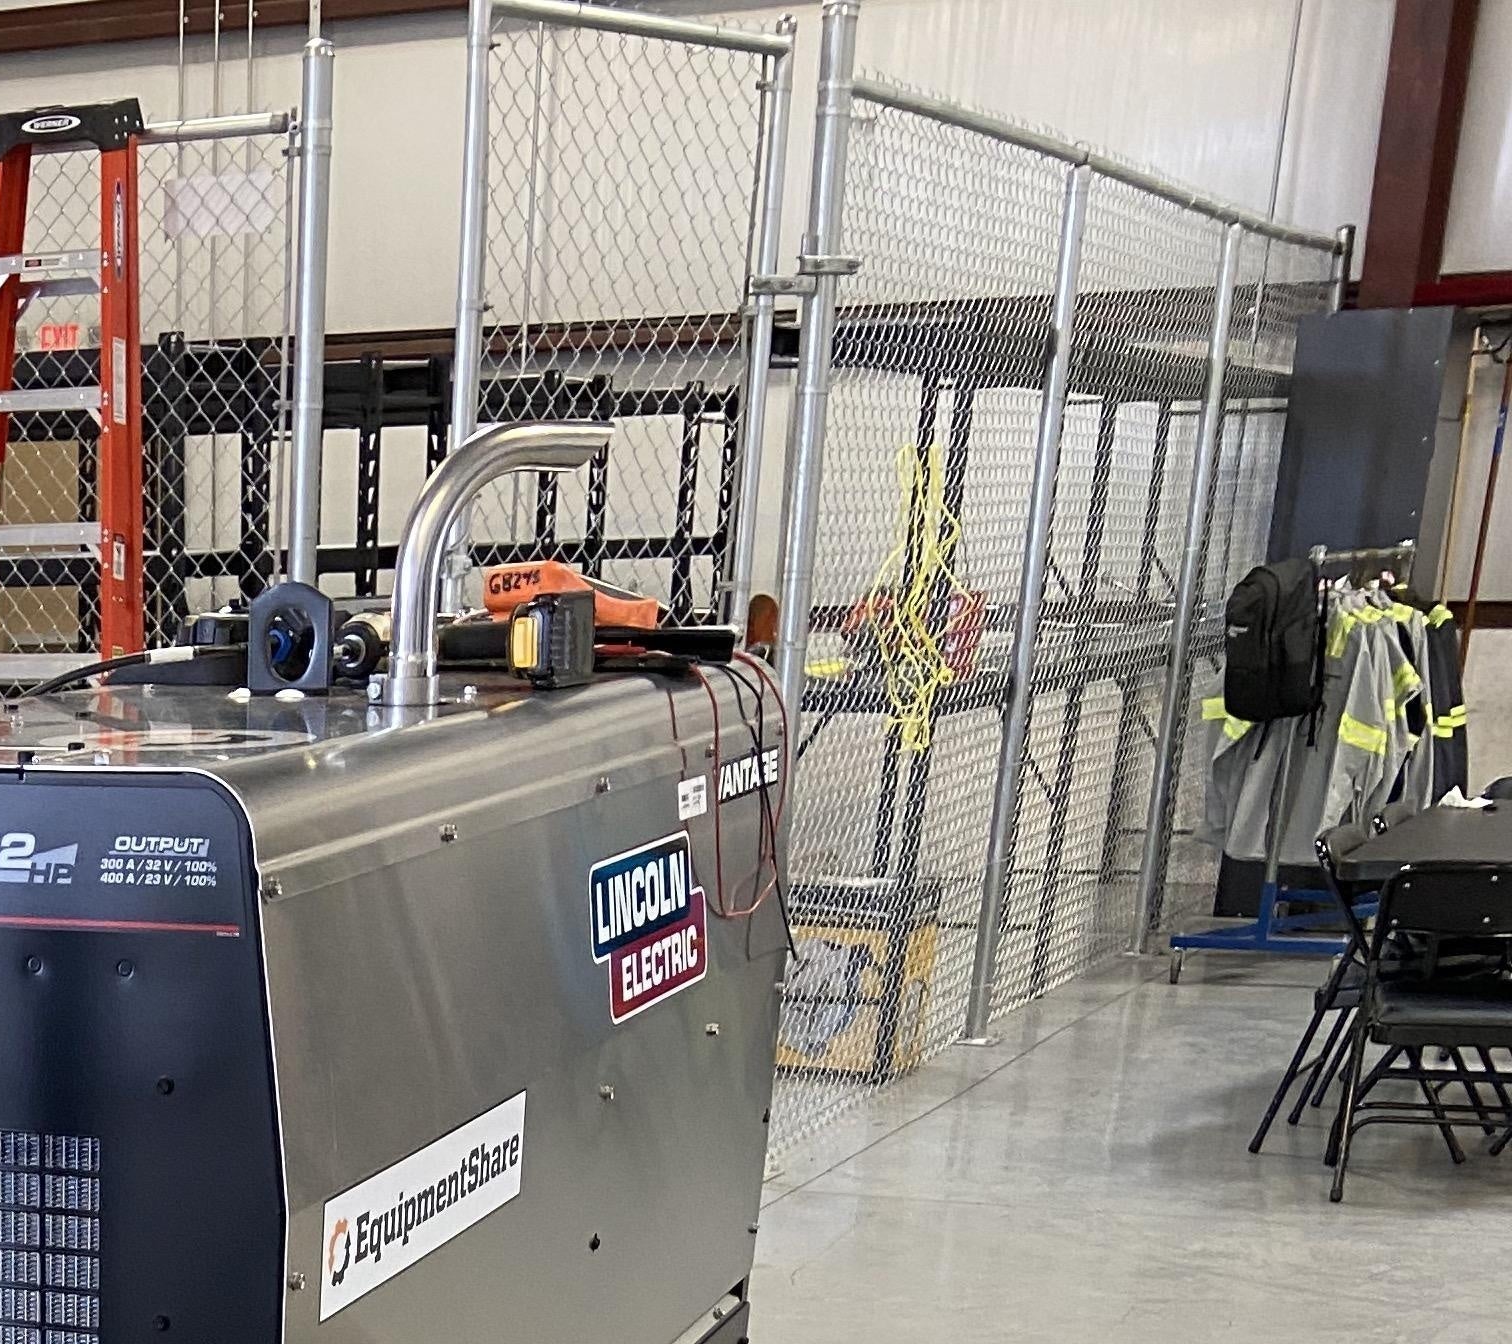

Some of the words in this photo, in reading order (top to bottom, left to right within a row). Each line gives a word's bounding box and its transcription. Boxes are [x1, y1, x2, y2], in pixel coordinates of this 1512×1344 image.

[114, 836, 204, 853] OUTPUT
[30, 862, 76, 884] HP
[100, 858, 123, 870] 300
[184, 861, 217, 873] 100%
[100, 872, 123, 884] 400
[184, 874, 217, 888] 100%
[595, 850, 686, 945] LINCOLN
[621, 925, 698, 1002] ELECTRIC
[355, 1133, 520, 1264] EquipmentShare
